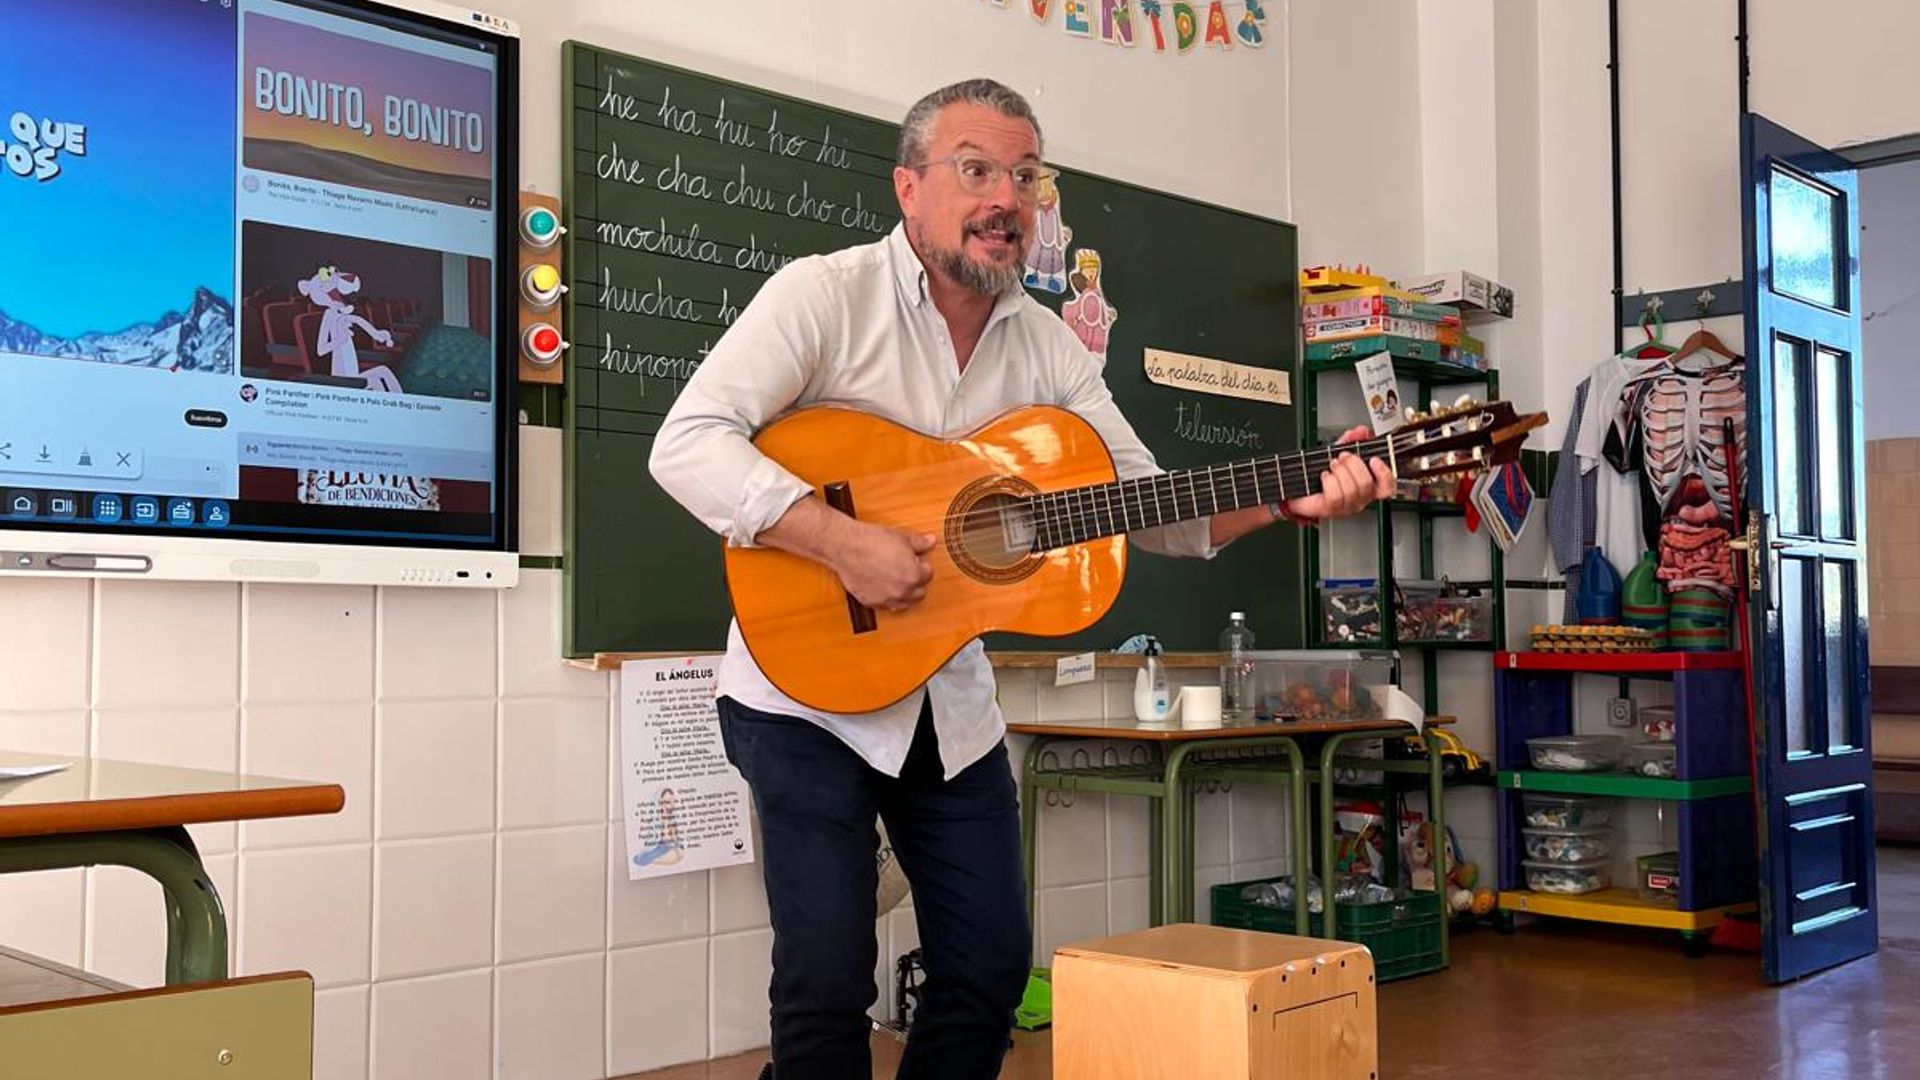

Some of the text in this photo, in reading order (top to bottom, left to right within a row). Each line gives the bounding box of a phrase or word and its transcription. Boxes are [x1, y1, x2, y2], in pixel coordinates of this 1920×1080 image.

[10, 112, 87, 156] QUE
[254, 66, 484, 154] BONITO, BONITO
[600, 75, 850, 169] he ha hu ho hi
[597, 142, 883, 233] che cha chu cho chi
[597, 216, 722, 263] mochila
[600, 266, 702, 321] hucha
[328, 487, 417, 506] DE BENDICIONES
[655, 668, 714, 682] EL ÁNGELUS
